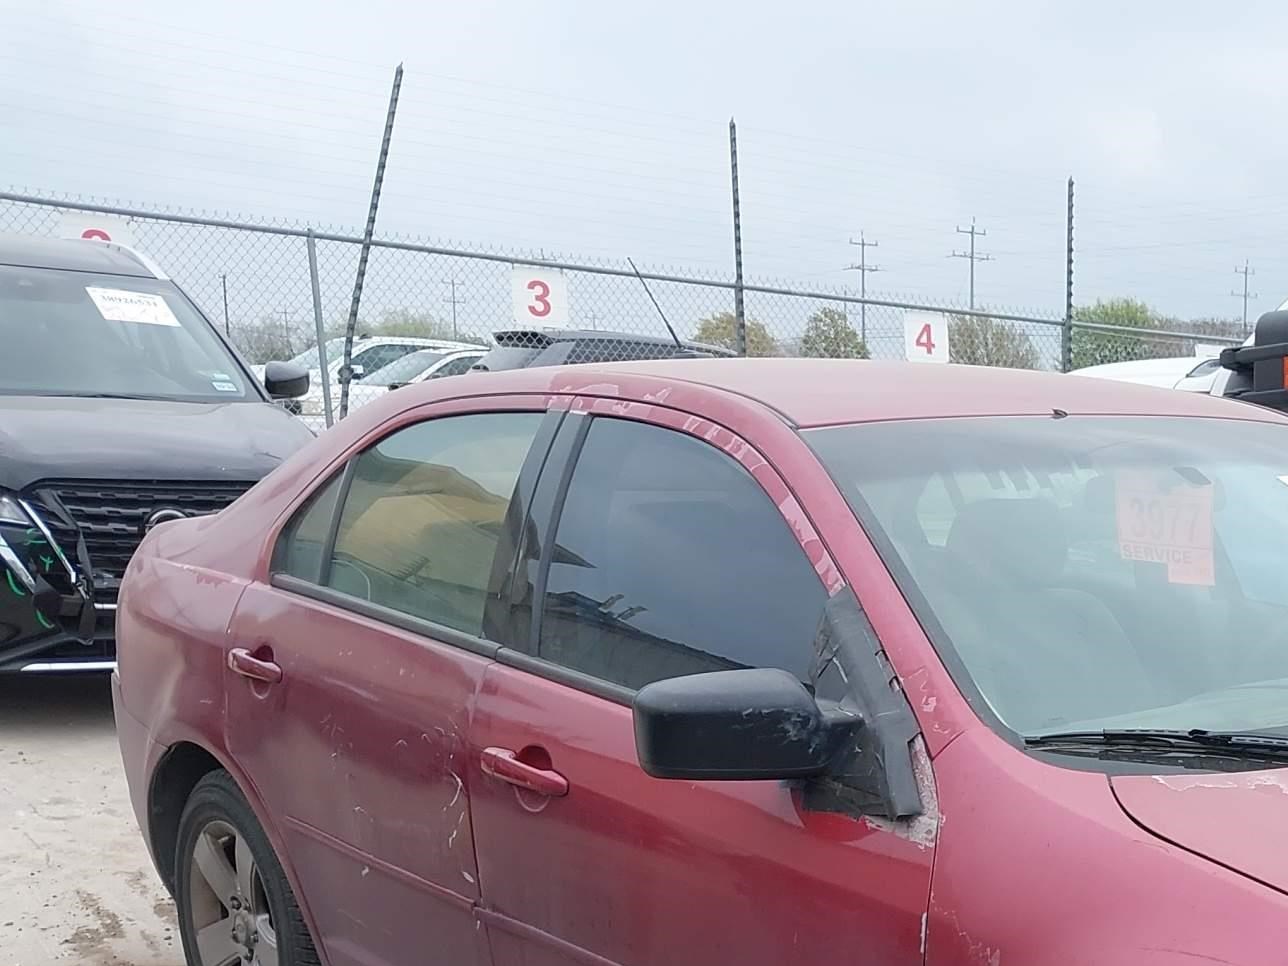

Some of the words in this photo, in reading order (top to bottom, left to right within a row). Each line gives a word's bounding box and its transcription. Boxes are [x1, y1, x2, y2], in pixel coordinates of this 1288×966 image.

[527, 281, 551, 316] 3
[916, 324, 935, 354] 4
[1122, 544, 1192, 565] SERVICE
